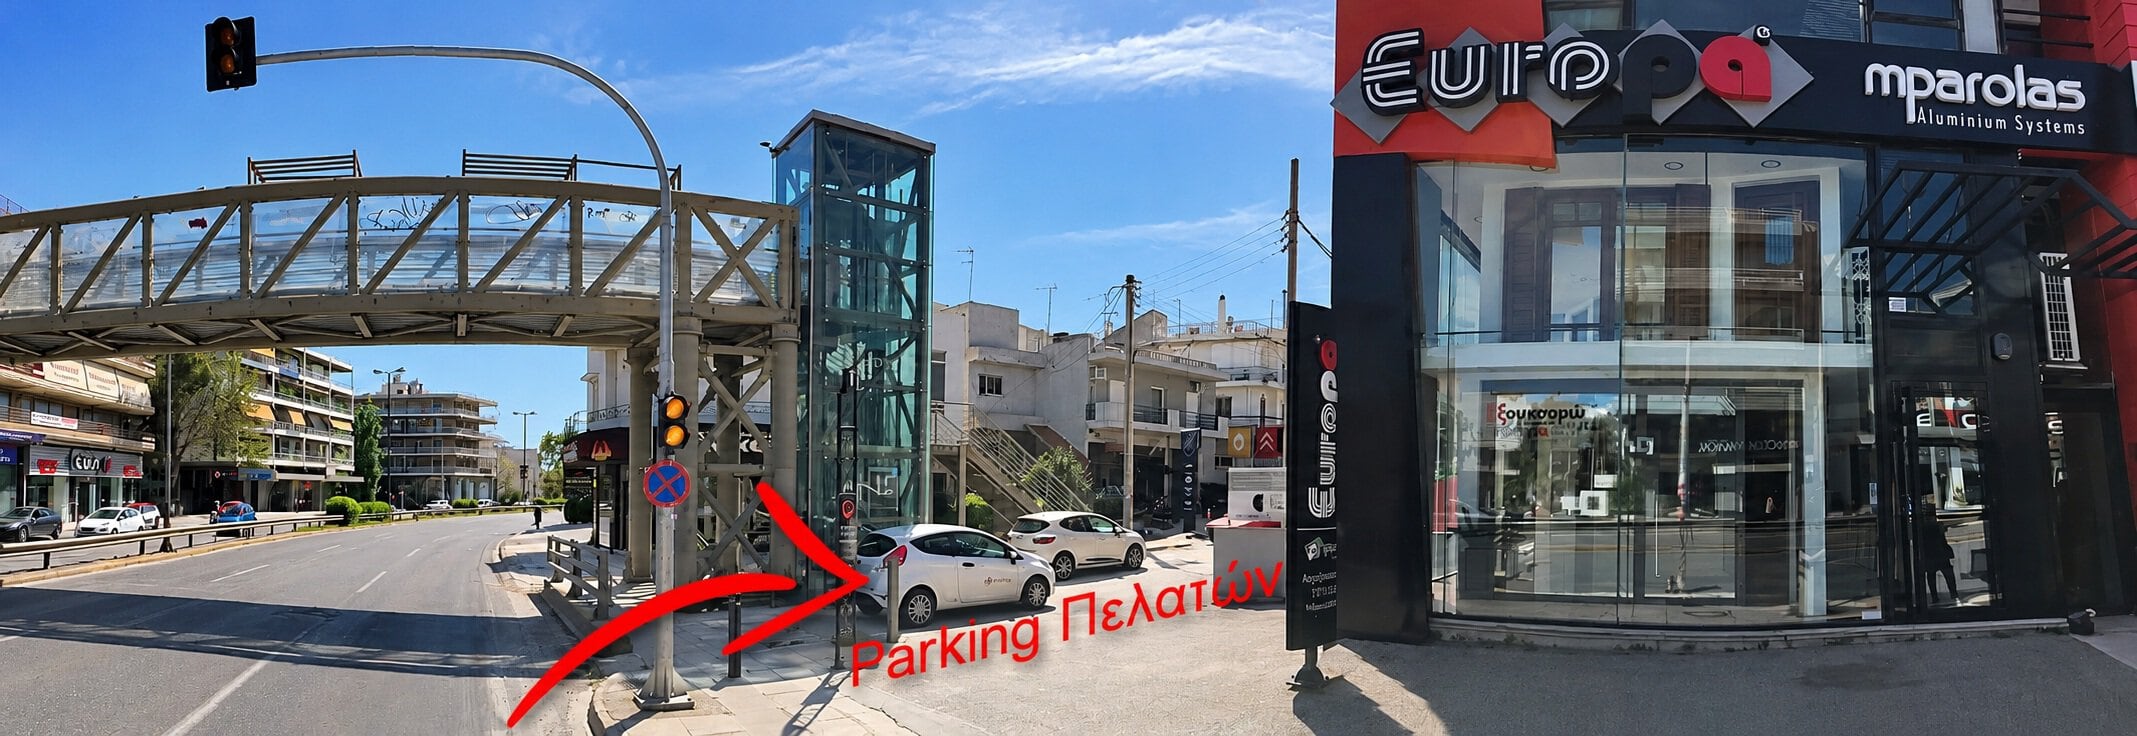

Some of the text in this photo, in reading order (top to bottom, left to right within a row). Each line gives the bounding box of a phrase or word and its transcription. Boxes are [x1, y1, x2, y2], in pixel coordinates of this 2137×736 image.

[1362, 28, 1772, 126] Europa
[1865, 63, 2086, 124] mparolas
[1917, 106, 2085, 136] Aluminium Systems
